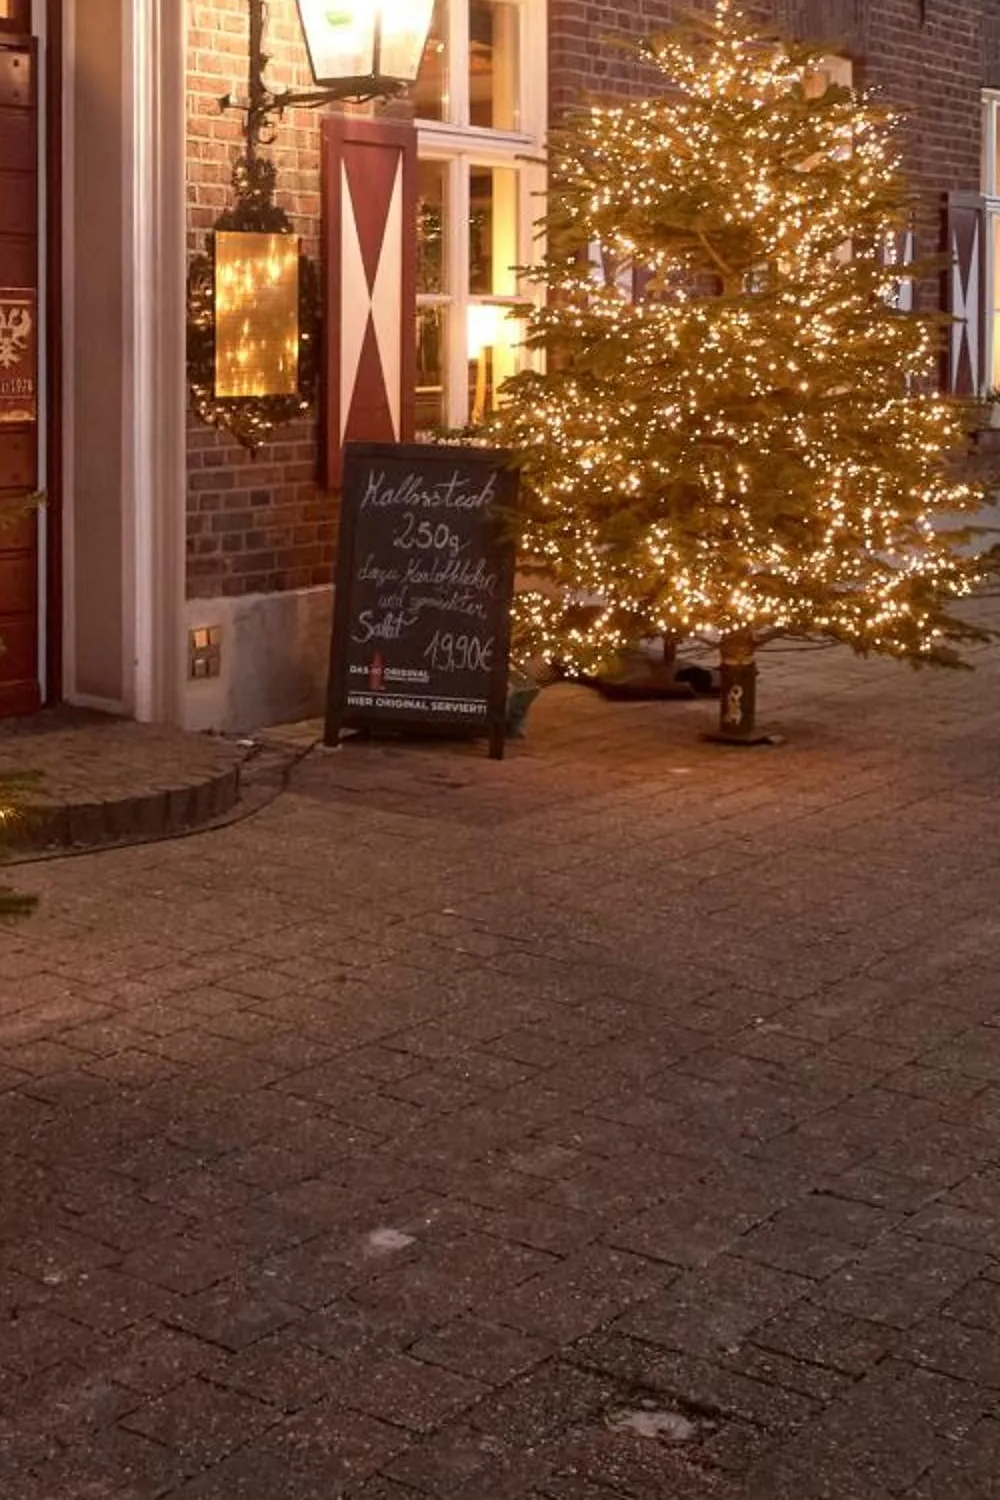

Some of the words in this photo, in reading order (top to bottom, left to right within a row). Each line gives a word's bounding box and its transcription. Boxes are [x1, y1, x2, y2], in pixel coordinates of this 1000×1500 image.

[393, 512, 471, 557] 250g
[347, 695, 373, 707] HIER
[375, 698, 429, 710] ORIGINAL
